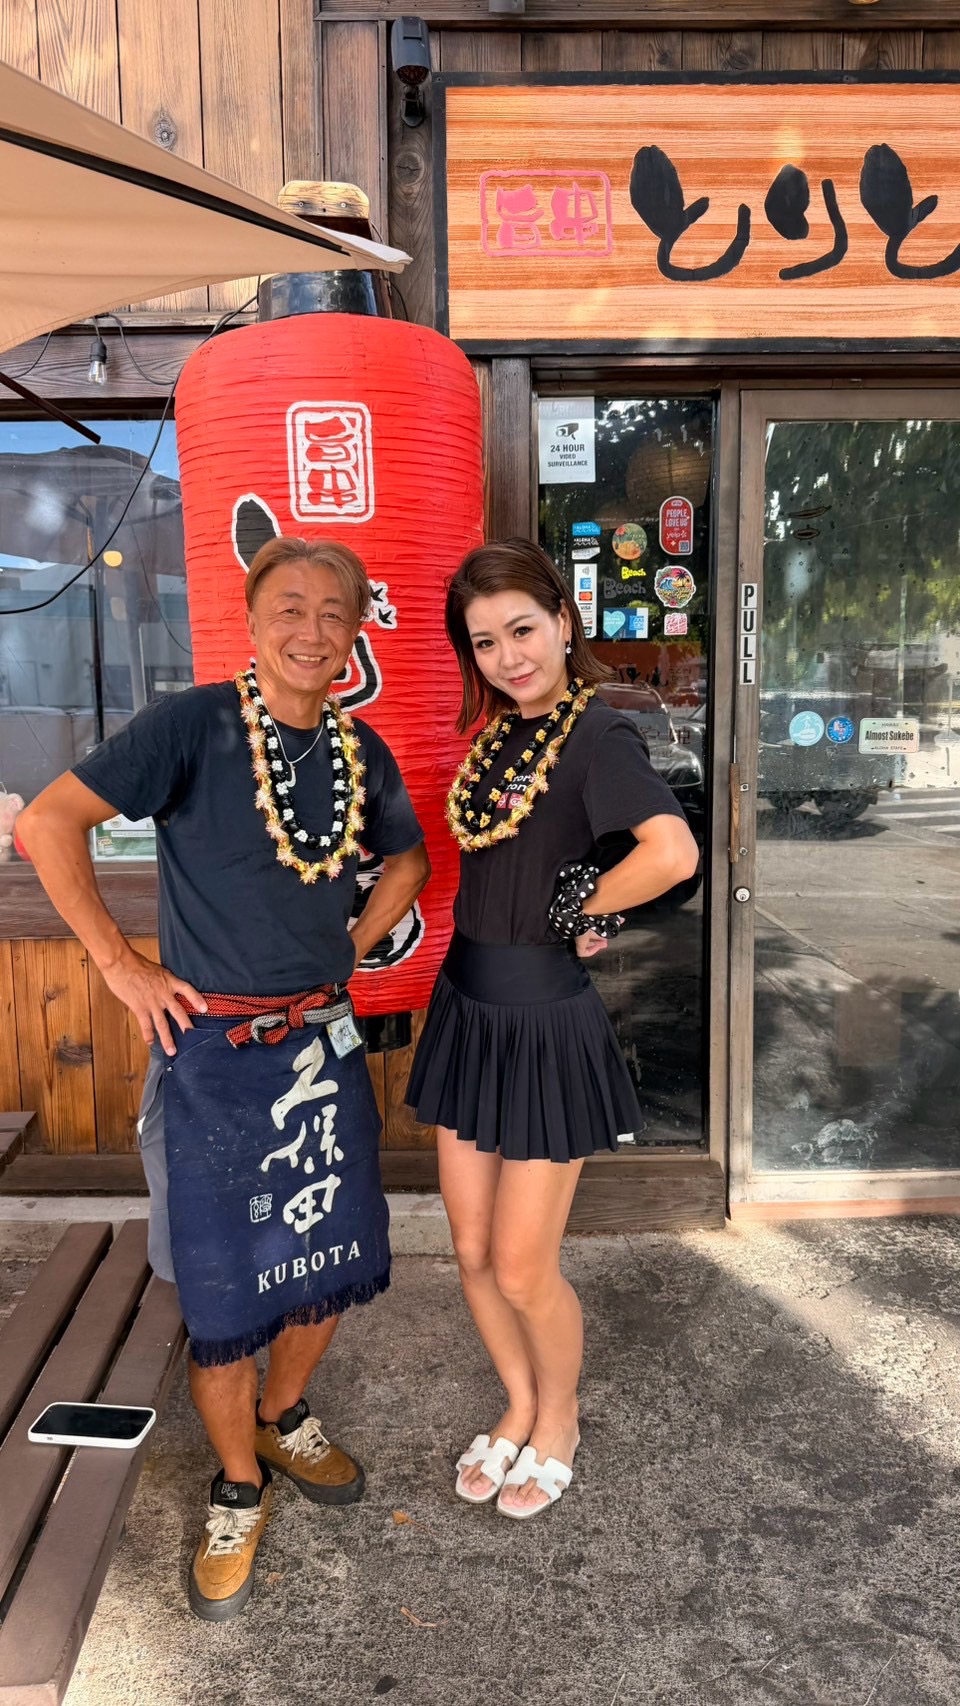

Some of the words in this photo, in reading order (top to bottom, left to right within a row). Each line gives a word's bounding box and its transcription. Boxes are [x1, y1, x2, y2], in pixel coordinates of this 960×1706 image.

[550, 444, 560, 453] 24
[562, 443, 585, 452] HOUR
[666, 508, 687, 518] PEOPLE
[665, 518, 679, 527] LOVE
[680, 518, 688, 527] US
[621, 566, 647, 580] Beach
[603, 577, 647, 599] Beach
[742, 584, 755, 684] PULL
[865, 730, 888, 741] Almost
[889, 730, 914, 741] Sukebe
[257, 1240, 361, 1294] KUBOTA
